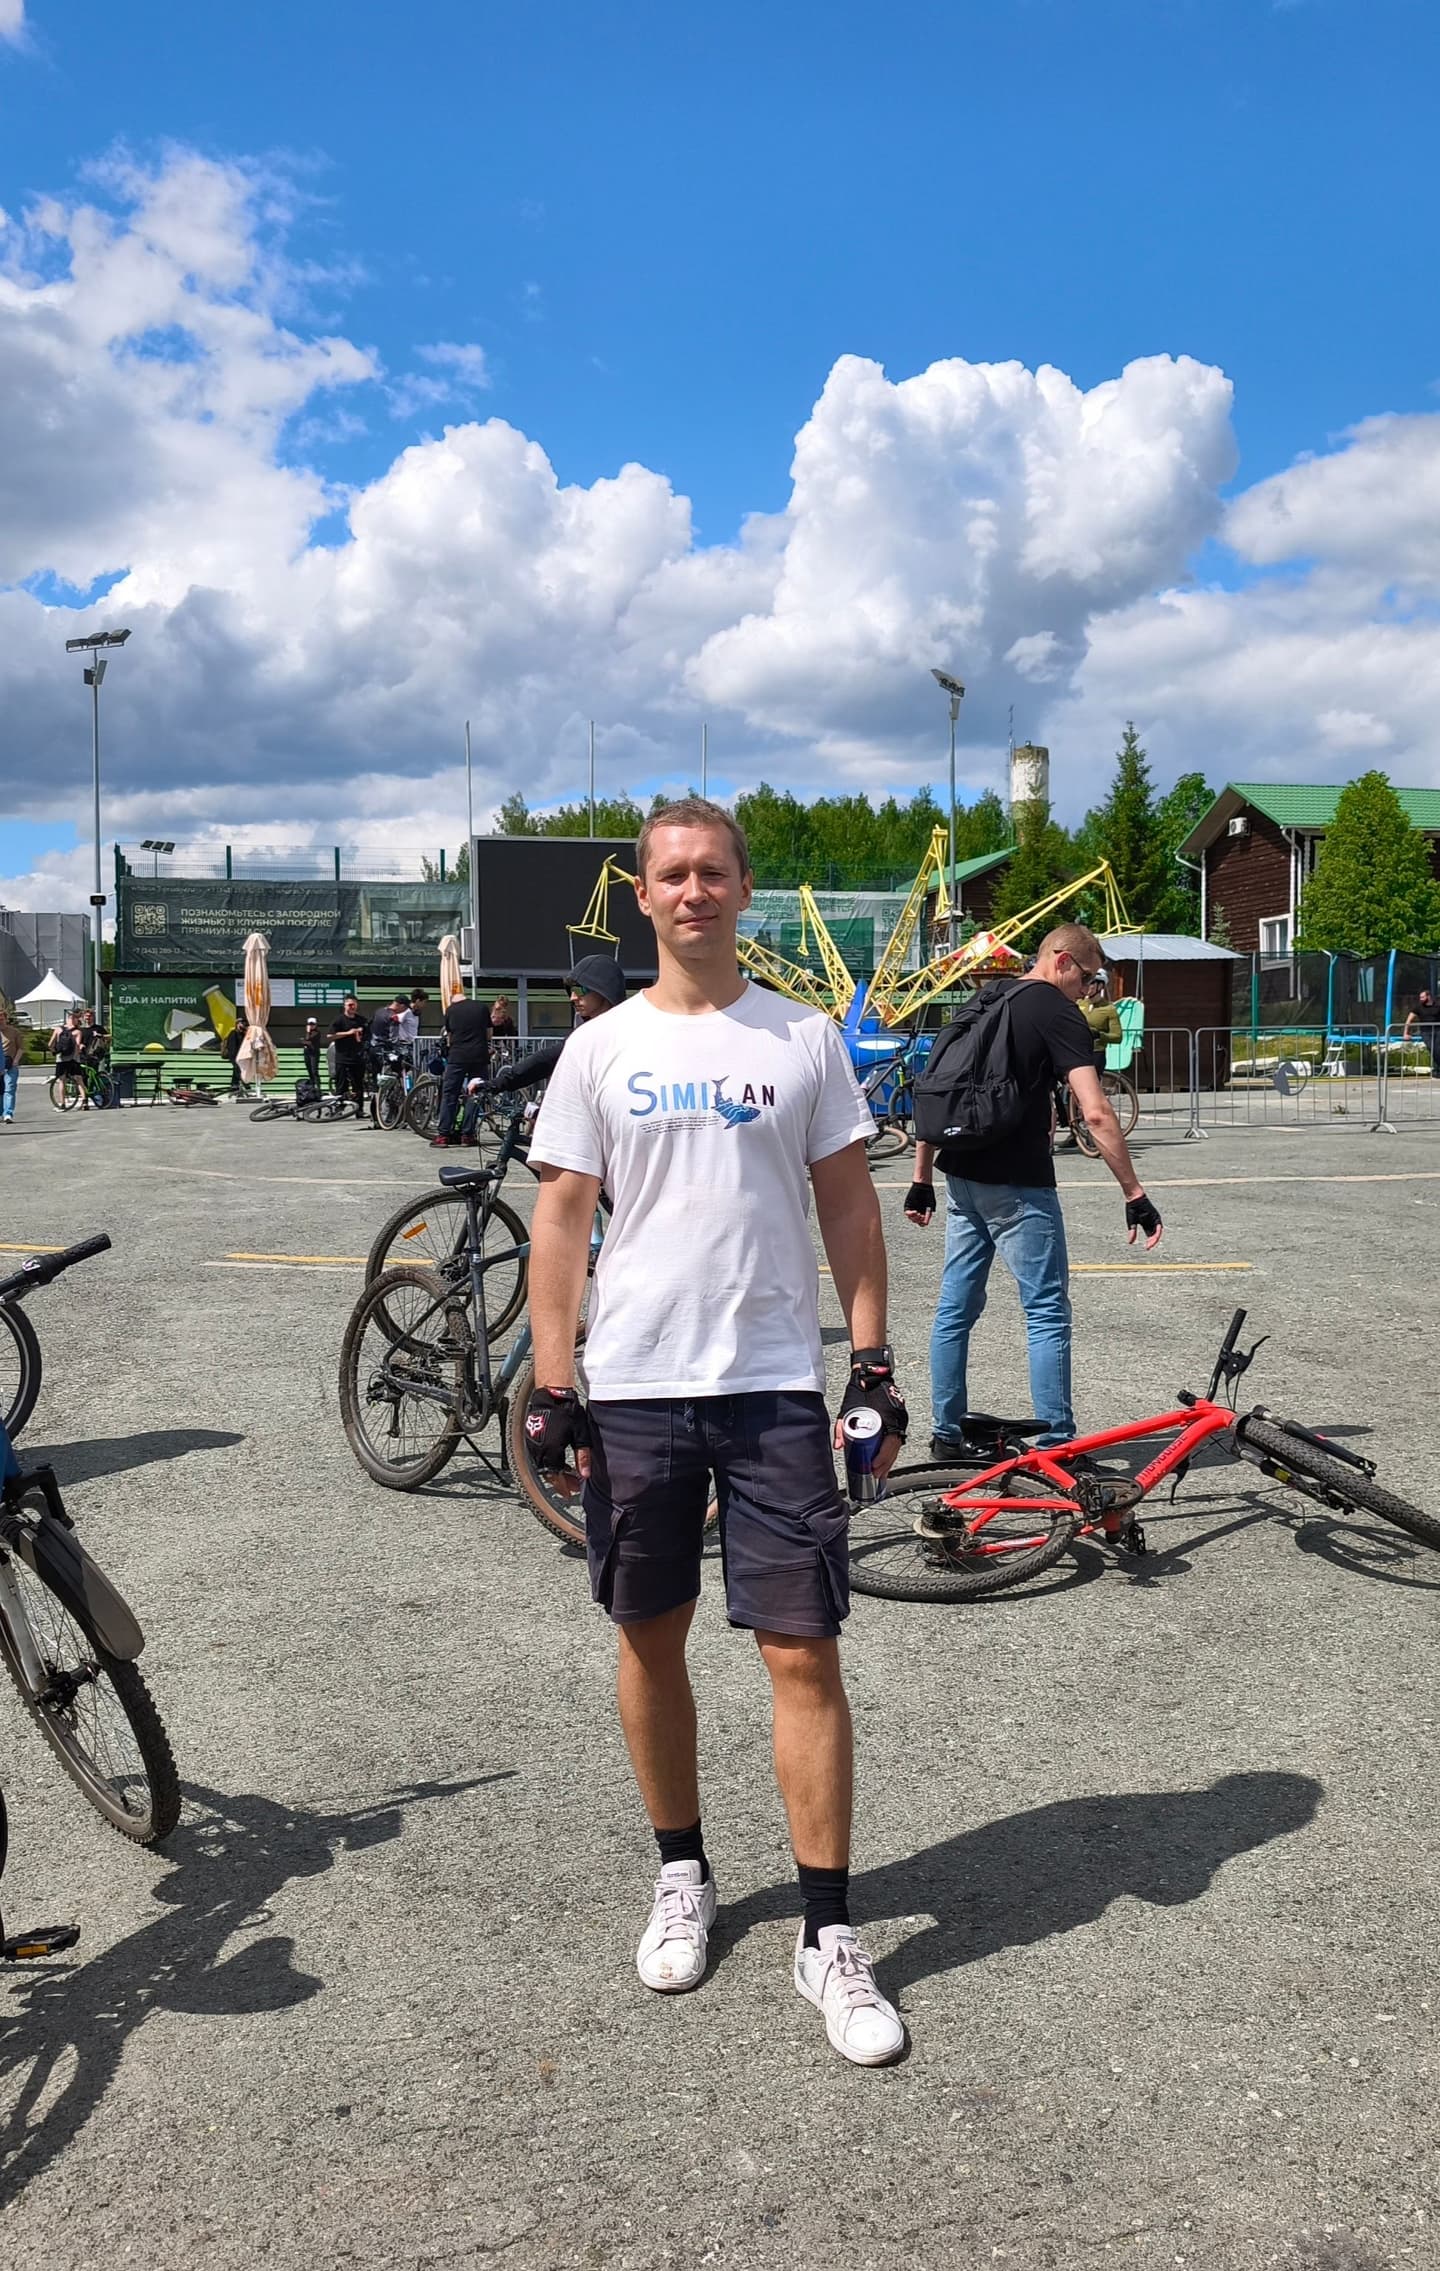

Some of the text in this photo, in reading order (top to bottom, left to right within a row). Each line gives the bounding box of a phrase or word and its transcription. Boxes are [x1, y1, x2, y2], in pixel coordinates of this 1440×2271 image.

[180, 908, 341, 919] ПОЗНАКОМЬТЕСЬ С ЗАГОРОДНОЙ
[181, 918, 226, 926] ЖИЗНЬЮ
[287, 918, 333, 927] ПОСЁЛКЕ
[119, 996, 140, 1004] ЕДА
